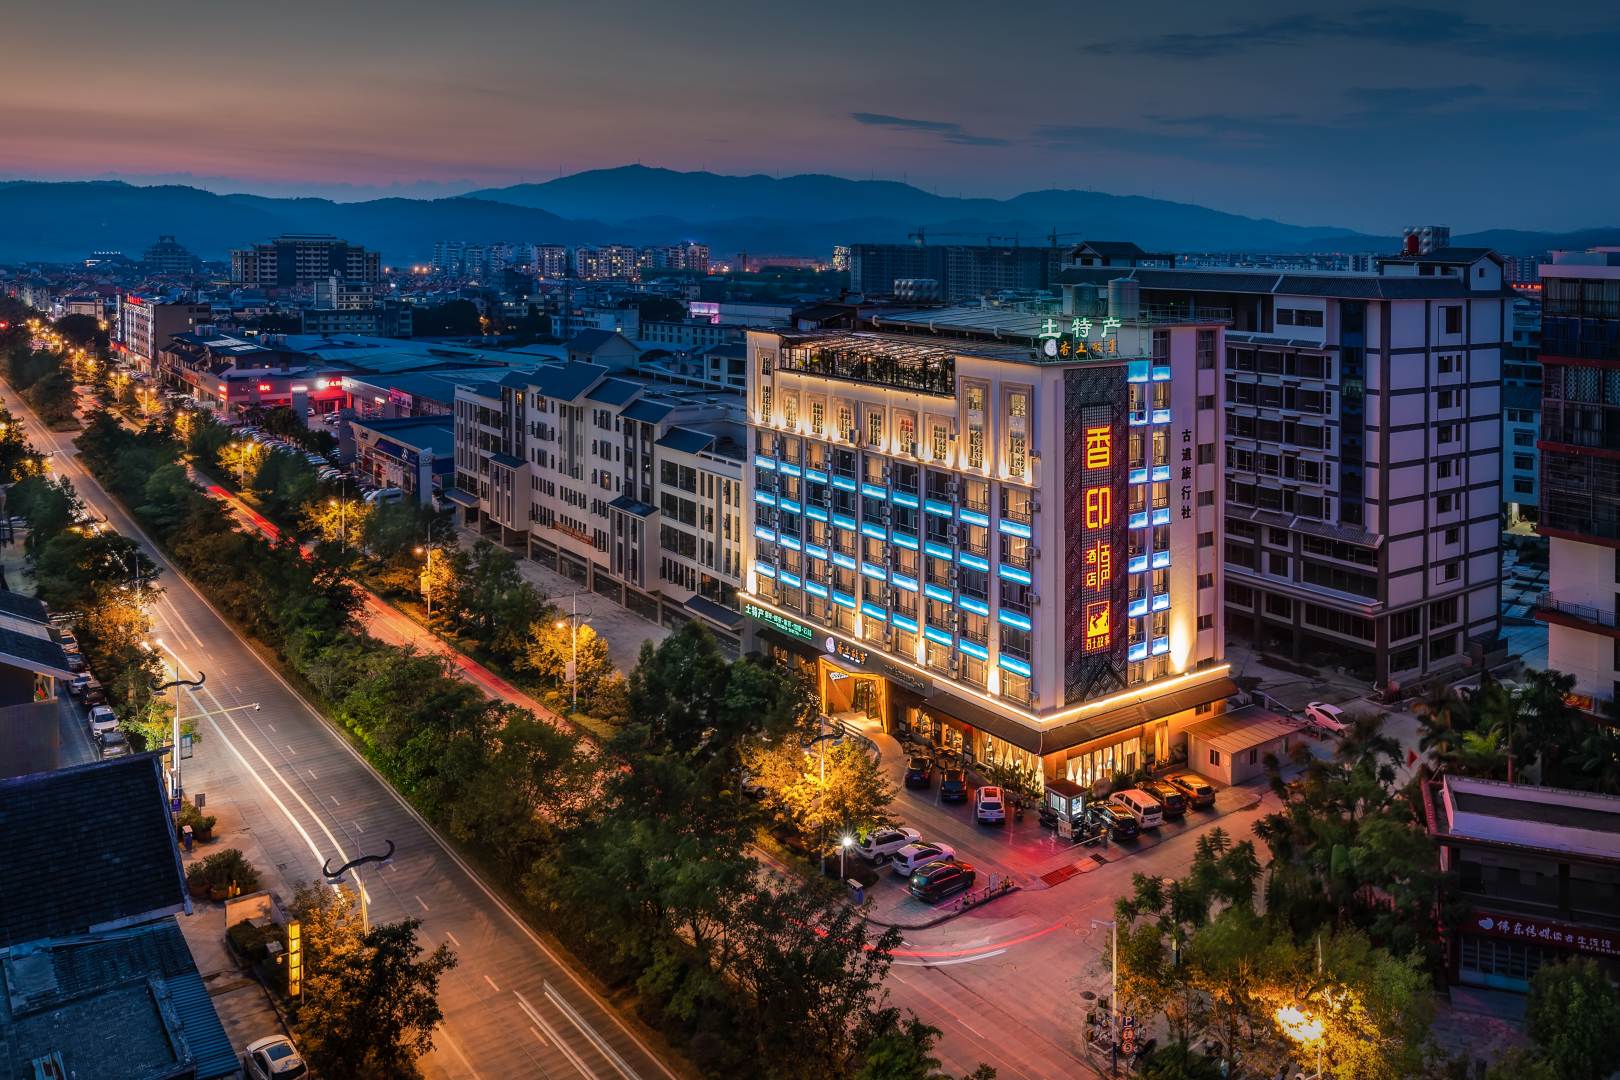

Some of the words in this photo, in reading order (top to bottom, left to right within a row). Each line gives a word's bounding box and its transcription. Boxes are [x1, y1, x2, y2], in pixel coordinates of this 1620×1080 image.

[1039, 316, 1122, 339] 土特产
[1086, 426, 1111, 529] 香印
[1181, 428, 1192, 519] 古道旅行社
[1086, 549, 1097, 587] 酒店
[1101, 544, 1111, 586] HOTEL
[745, 603, 765, 619] 土特产
